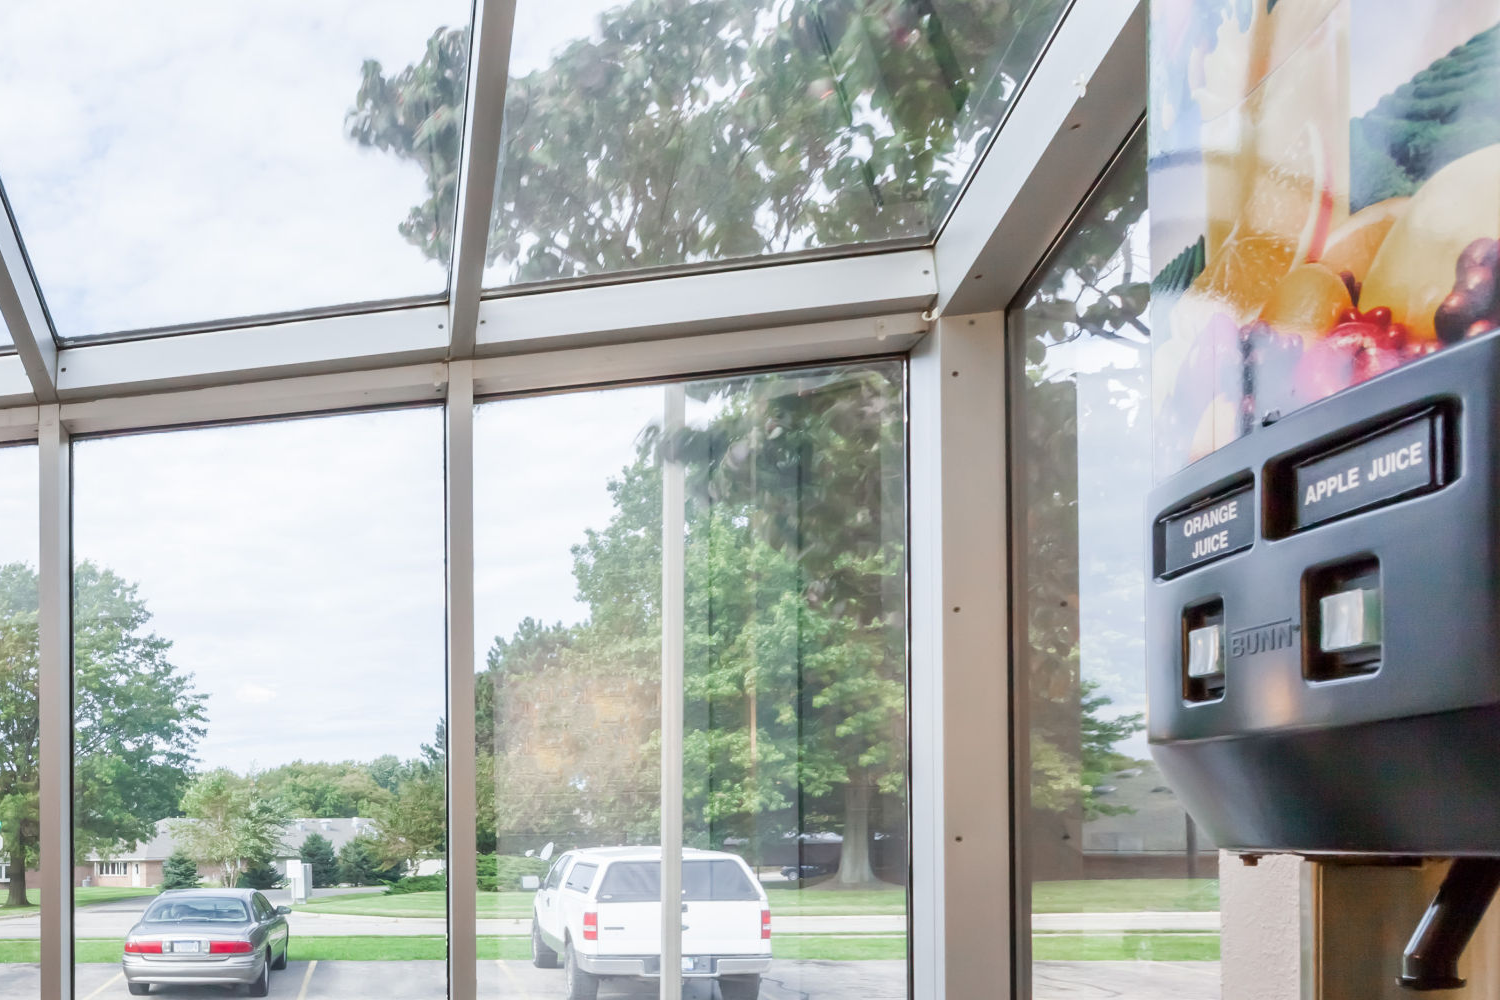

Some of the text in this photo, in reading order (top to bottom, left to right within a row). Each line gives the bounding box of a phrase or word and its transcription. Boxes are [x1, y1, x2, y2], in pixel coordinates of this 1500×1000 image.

[1304, 442, 1422, 505] APPLE JUICE
[1184, 501, 1237, 537] ORANGE
[1192, 531, 1228, 559] JUICE
[1231, 624, 1293, 659] BUNN
